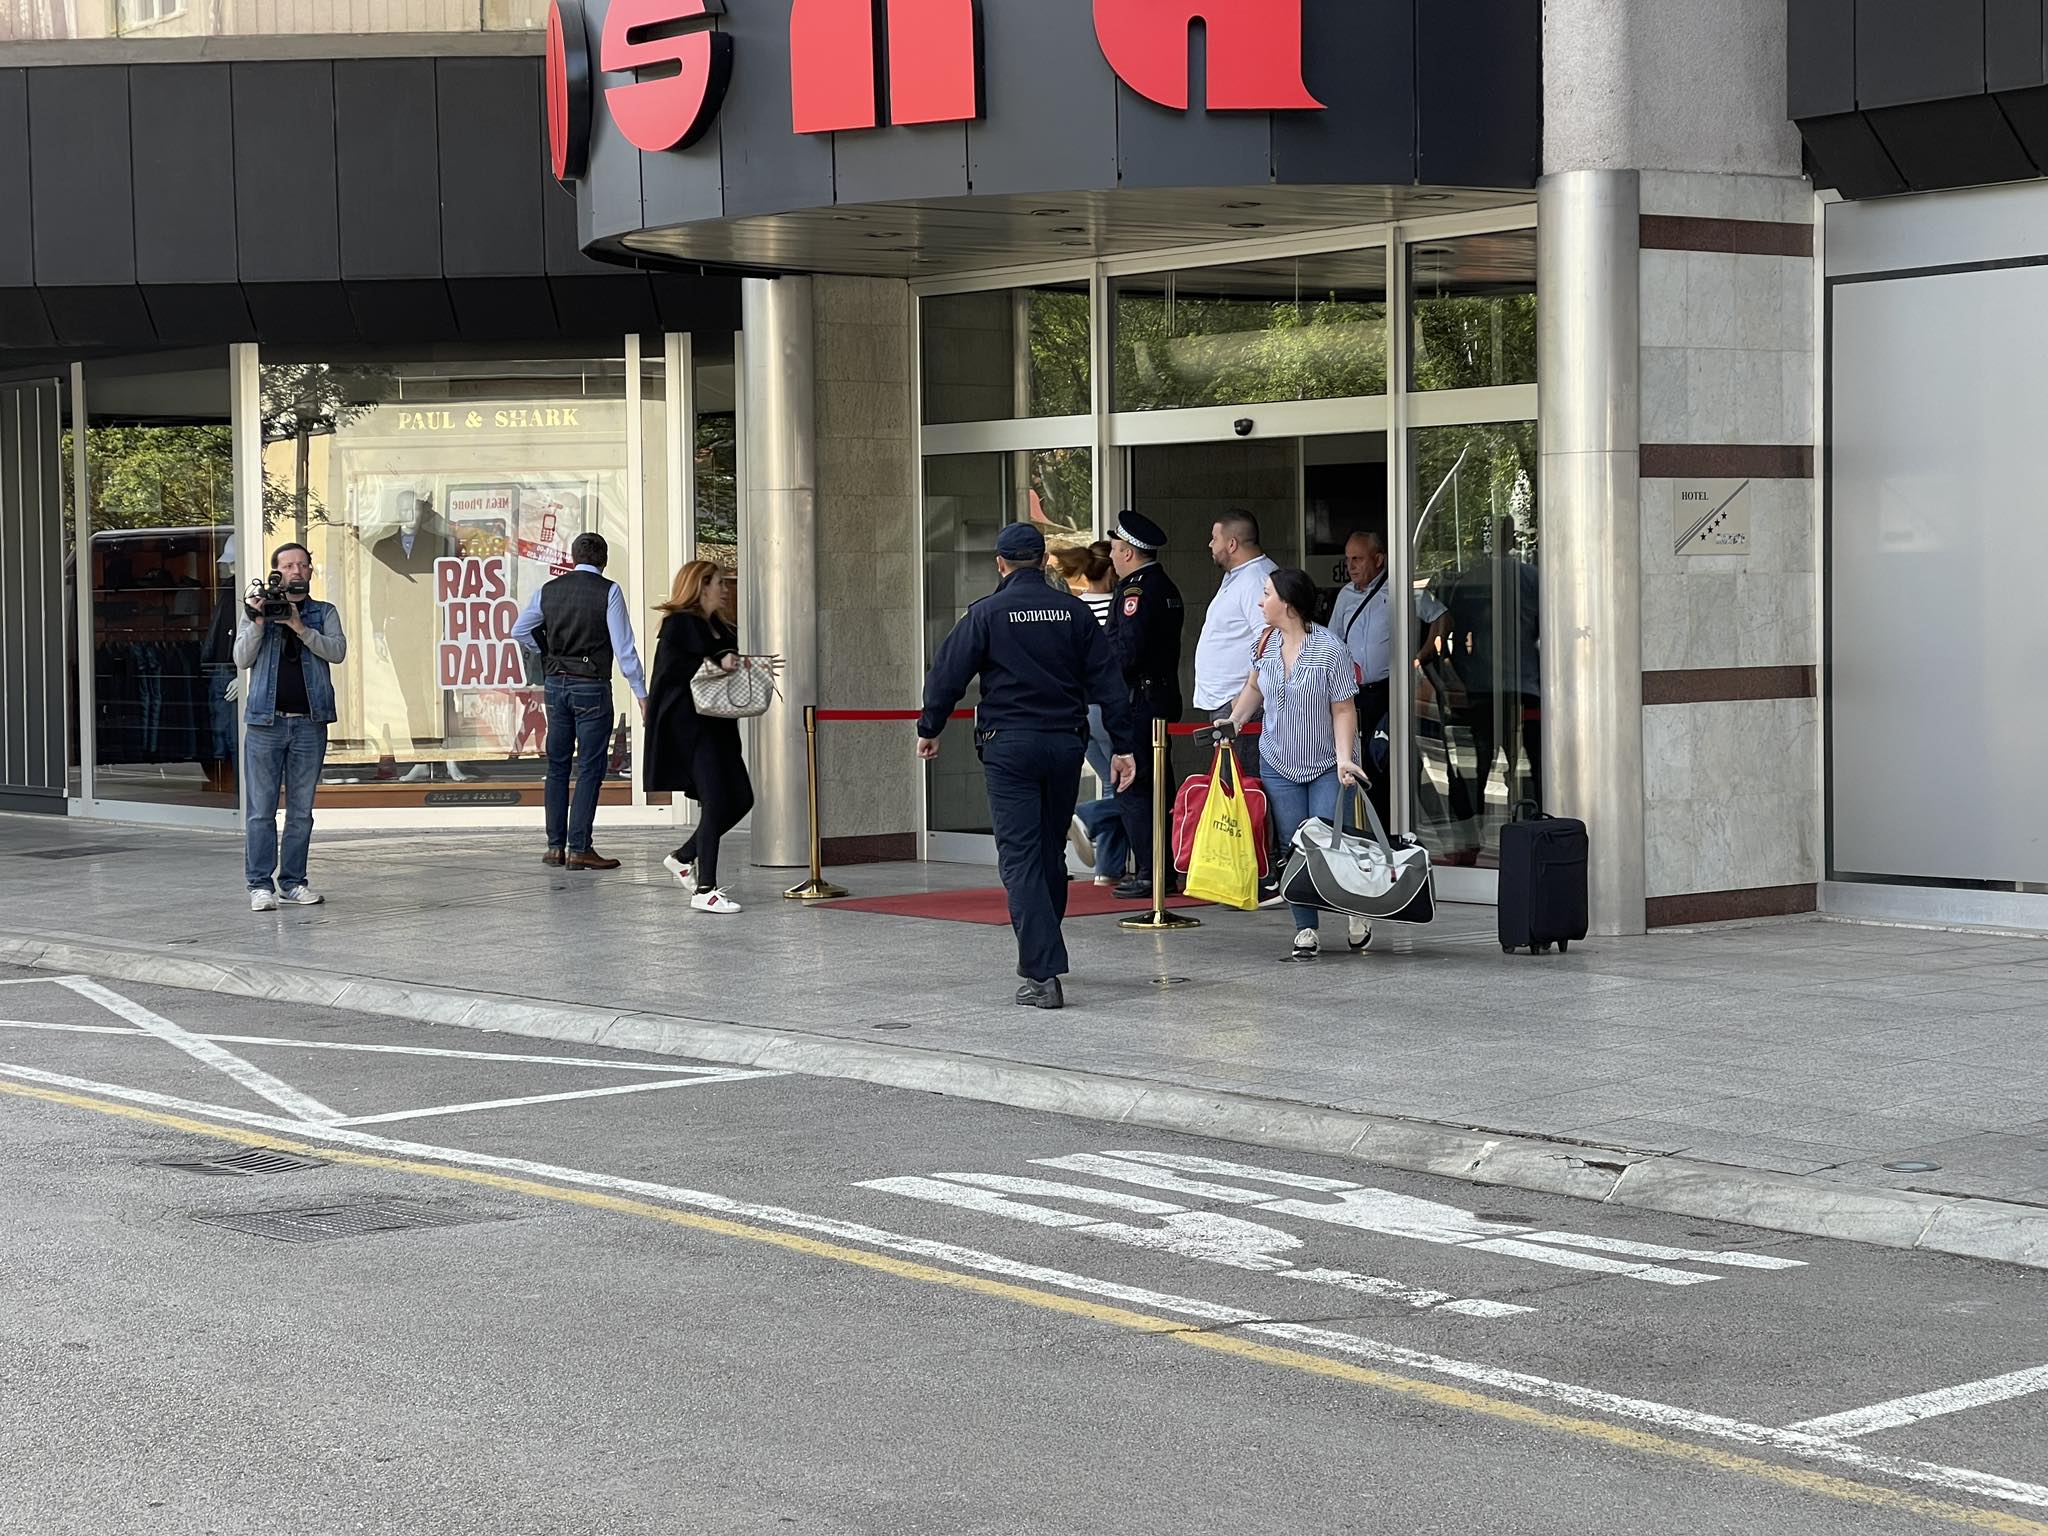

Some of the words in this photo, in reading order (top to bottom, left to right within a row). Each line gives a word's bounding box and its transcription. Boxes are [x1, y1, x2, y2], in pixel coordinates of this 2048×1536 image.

[398, 411, 456, 430] PAUL
[465, 410, 483, 428] &
[495, 408, 579, 428] SHARK
[1681, 491, 1709, 501] HOTEL
[438, 559, 506, 602] RAS
[449, 601, 518, 641] PRO
[1009, 609, 1072, 623] ПОЛИЦИЈА
[440, 643, 523, 685] DAJA
